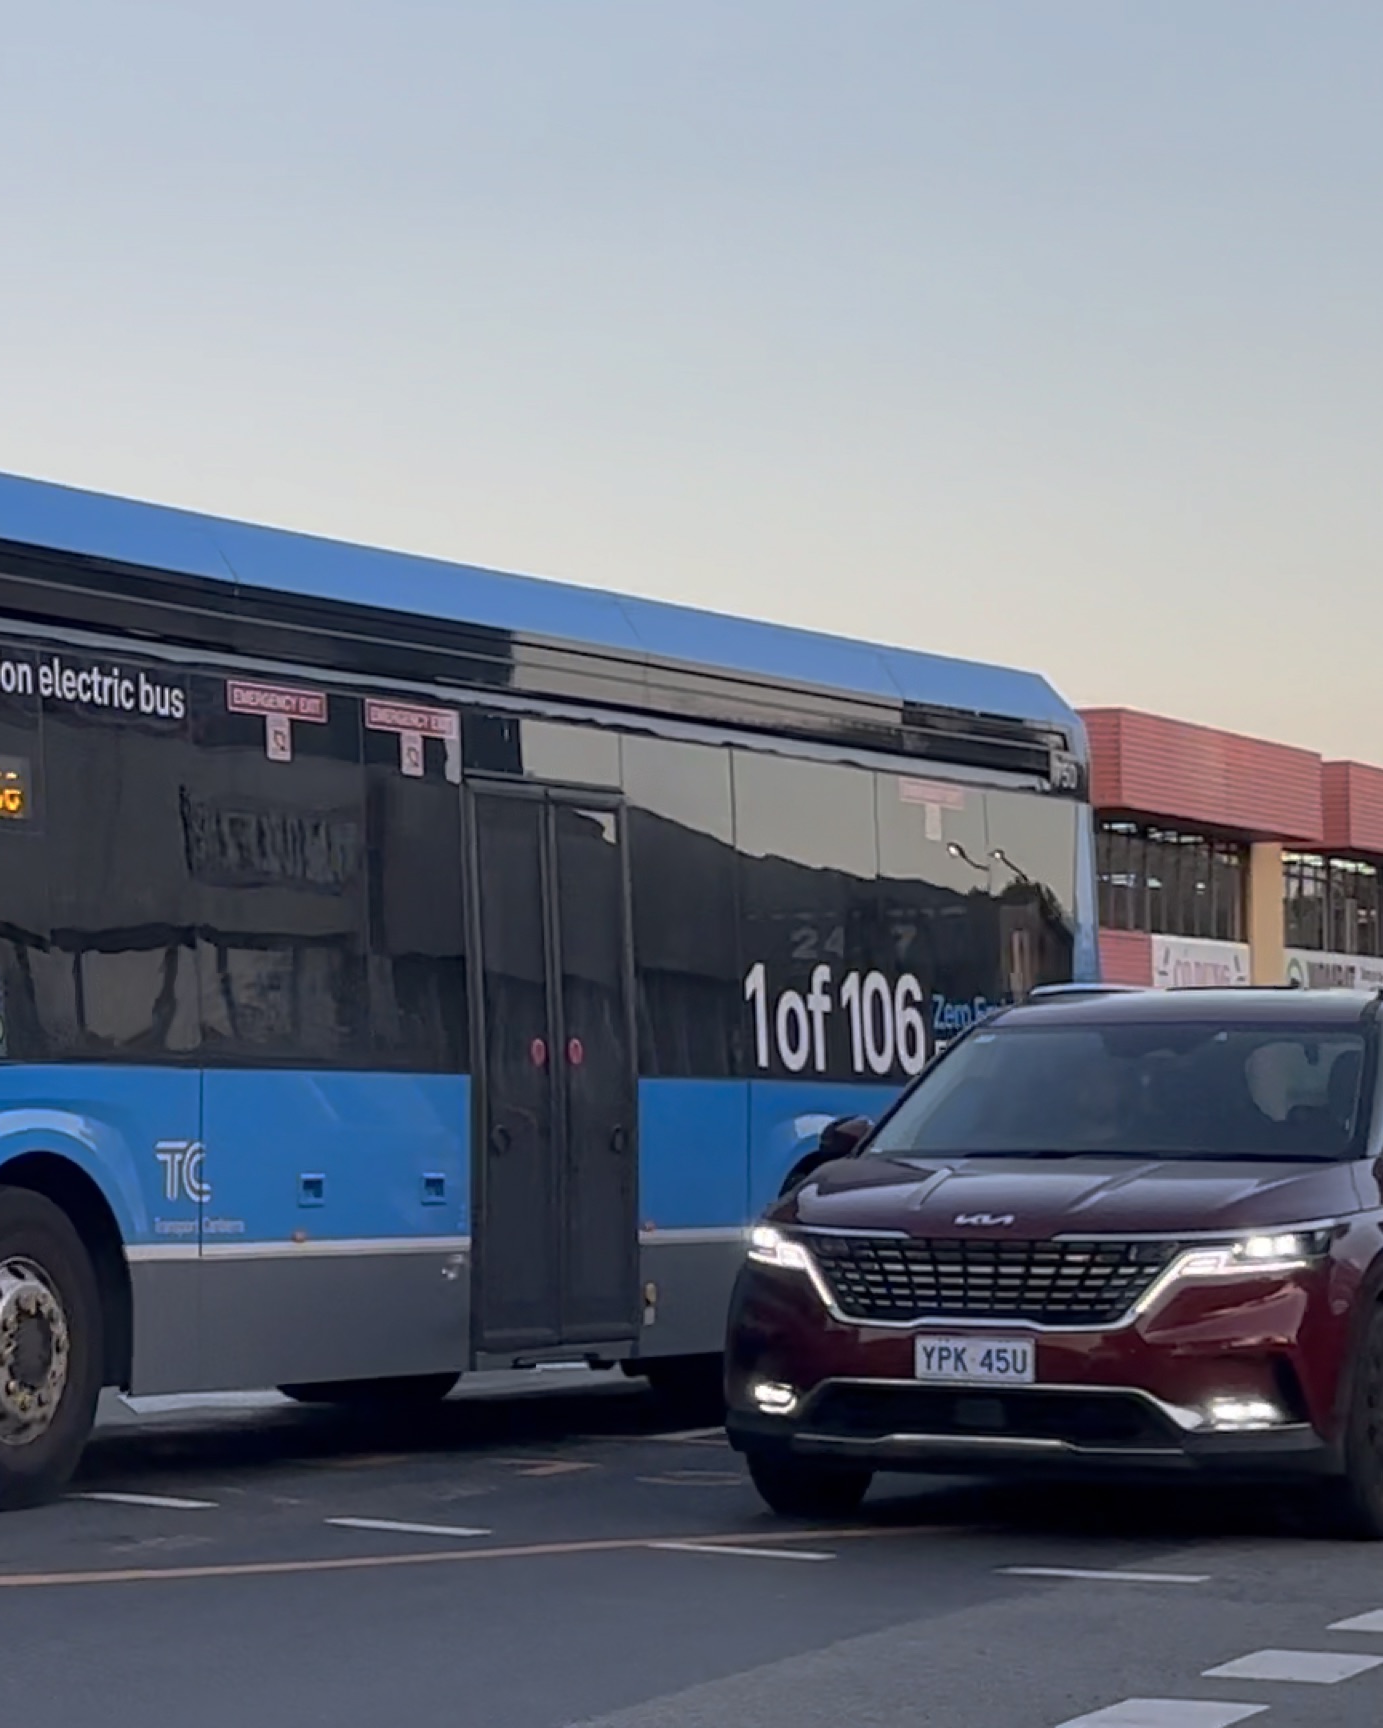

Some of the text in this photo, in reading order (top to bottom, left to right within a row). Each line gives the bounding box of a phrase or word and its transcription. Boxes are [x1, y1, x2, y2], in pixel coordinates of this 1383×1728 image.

[39, 657, 135, 711] electric
[139, 672, 185, 719] bus
[744, 963, 925, 1075] 1 of 106
[155, 1140, 212, 1203] TC
[922, 1345, 1028, 1374] YPK 45U
